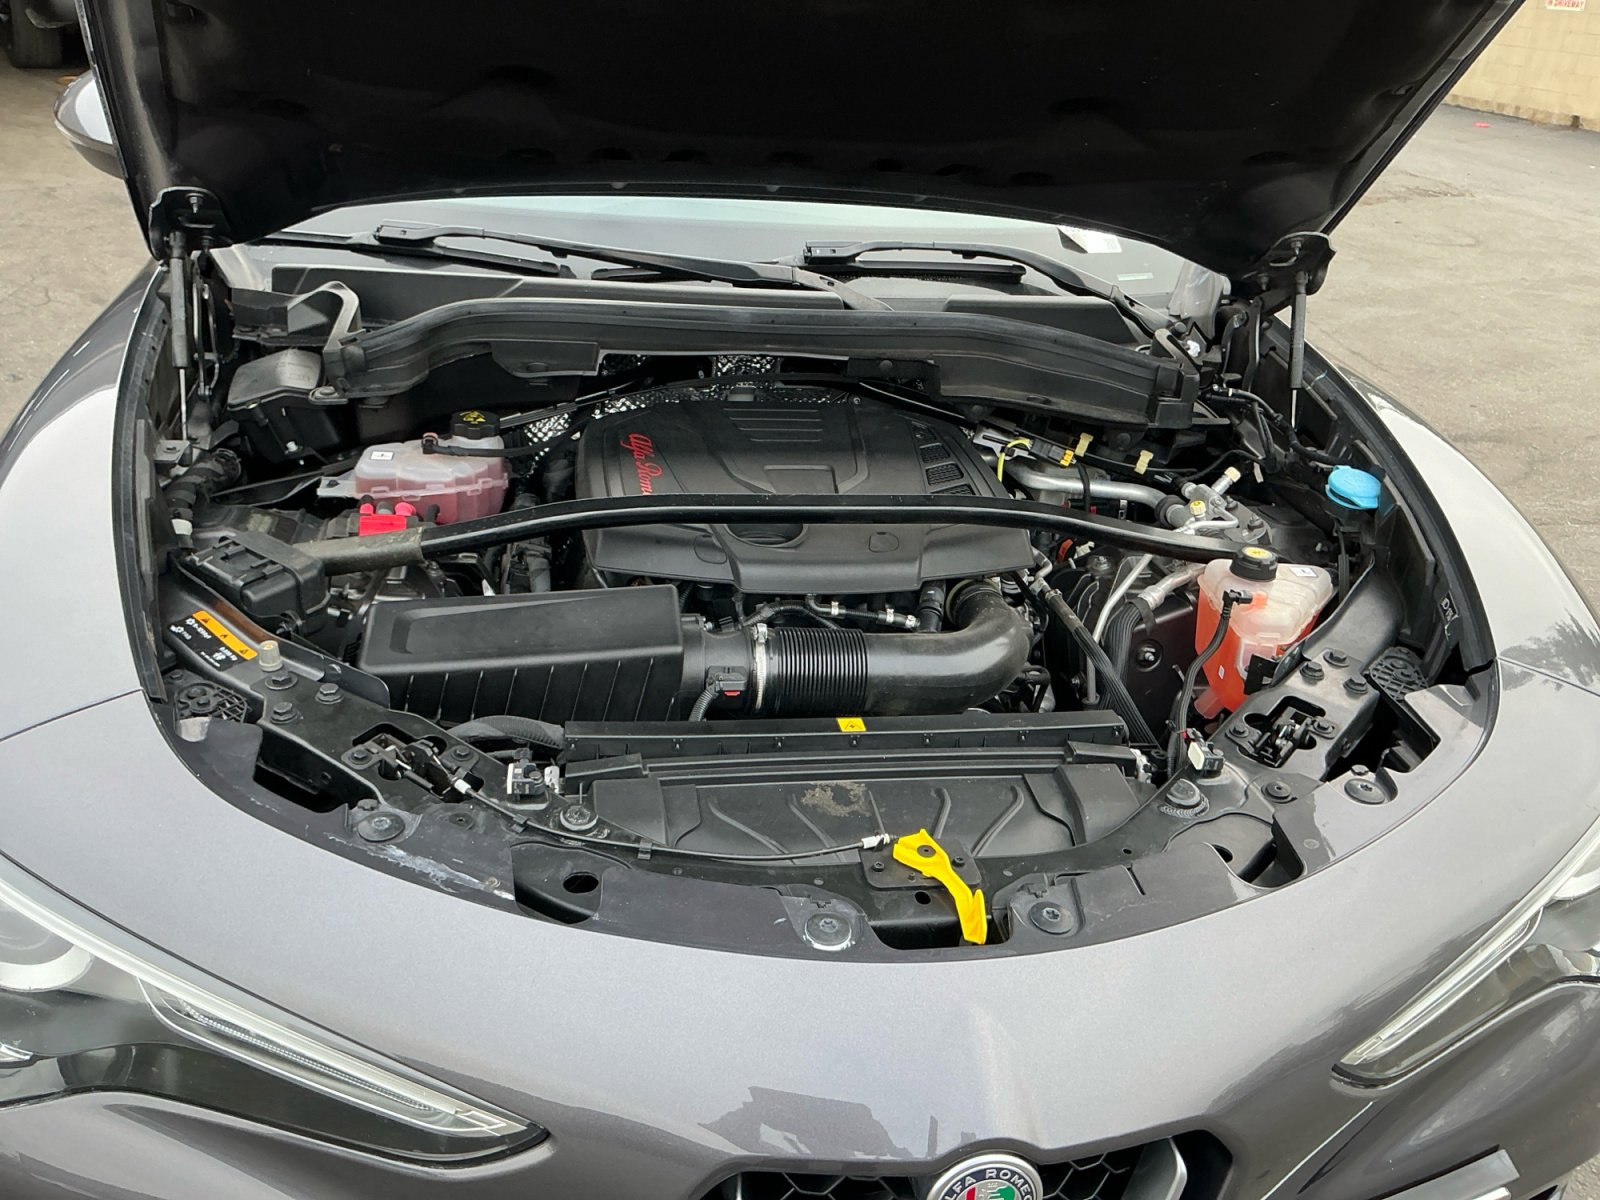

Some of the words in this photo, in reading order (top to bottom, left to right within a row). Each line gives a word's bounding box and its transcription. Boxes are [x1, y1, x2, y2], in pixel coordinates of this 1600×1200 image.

[620, 433, 655, 460] Alfa
[635, 461, 662, 495] Rom
[944, 1176, 977, 1200] LFA
